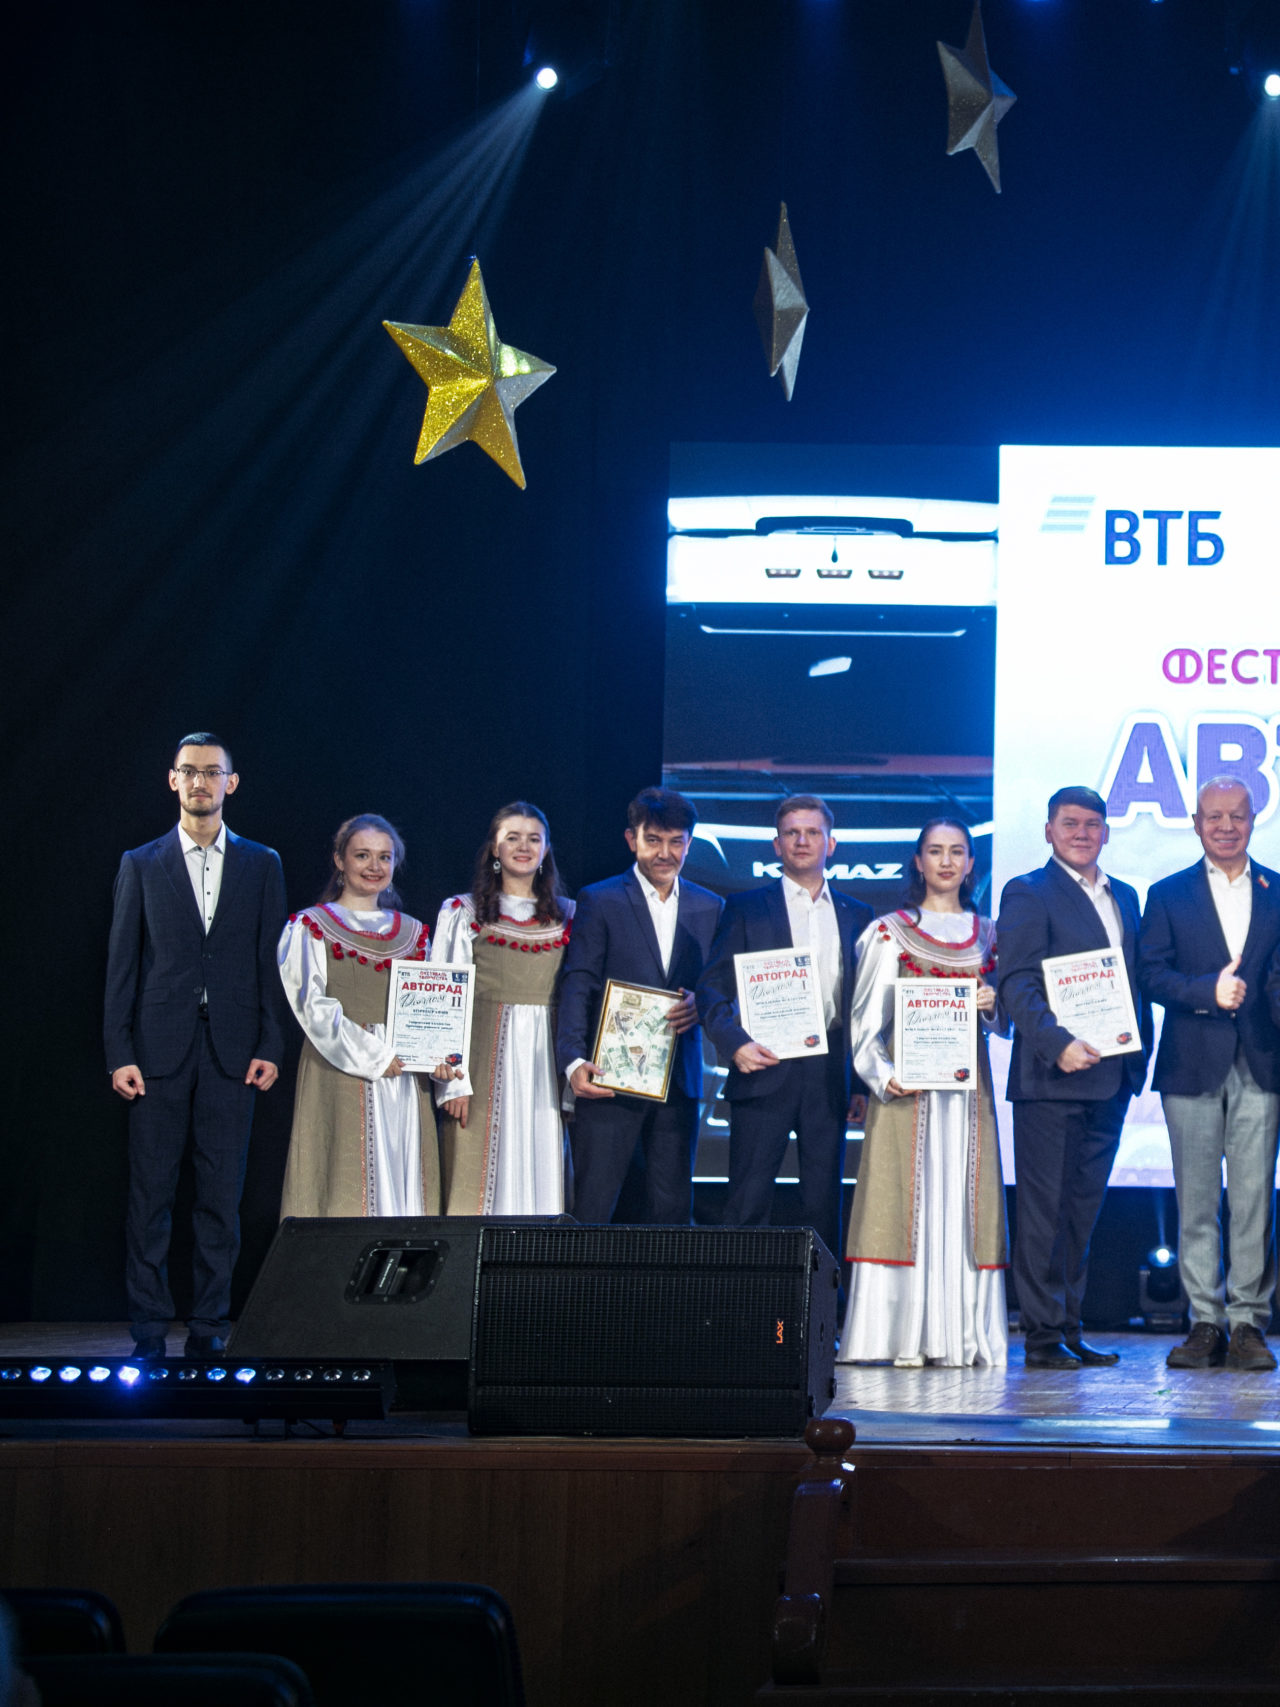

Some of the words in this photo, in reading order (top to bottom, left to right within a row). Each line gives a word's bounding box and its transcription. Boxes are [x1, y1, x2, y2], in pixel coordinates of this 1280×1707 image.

[1104, 509, 1225, 566] ВТБ
[752, 861, 903, 880] KMAZ
[749, 969, 808, 983] АВТОГРАД
[1058, 969, 1115, 986] АВТОГРАД
[401, 981, 463, 995] АВТОГРАД
[907, 999, 966, 1009] АВТОГРАД
